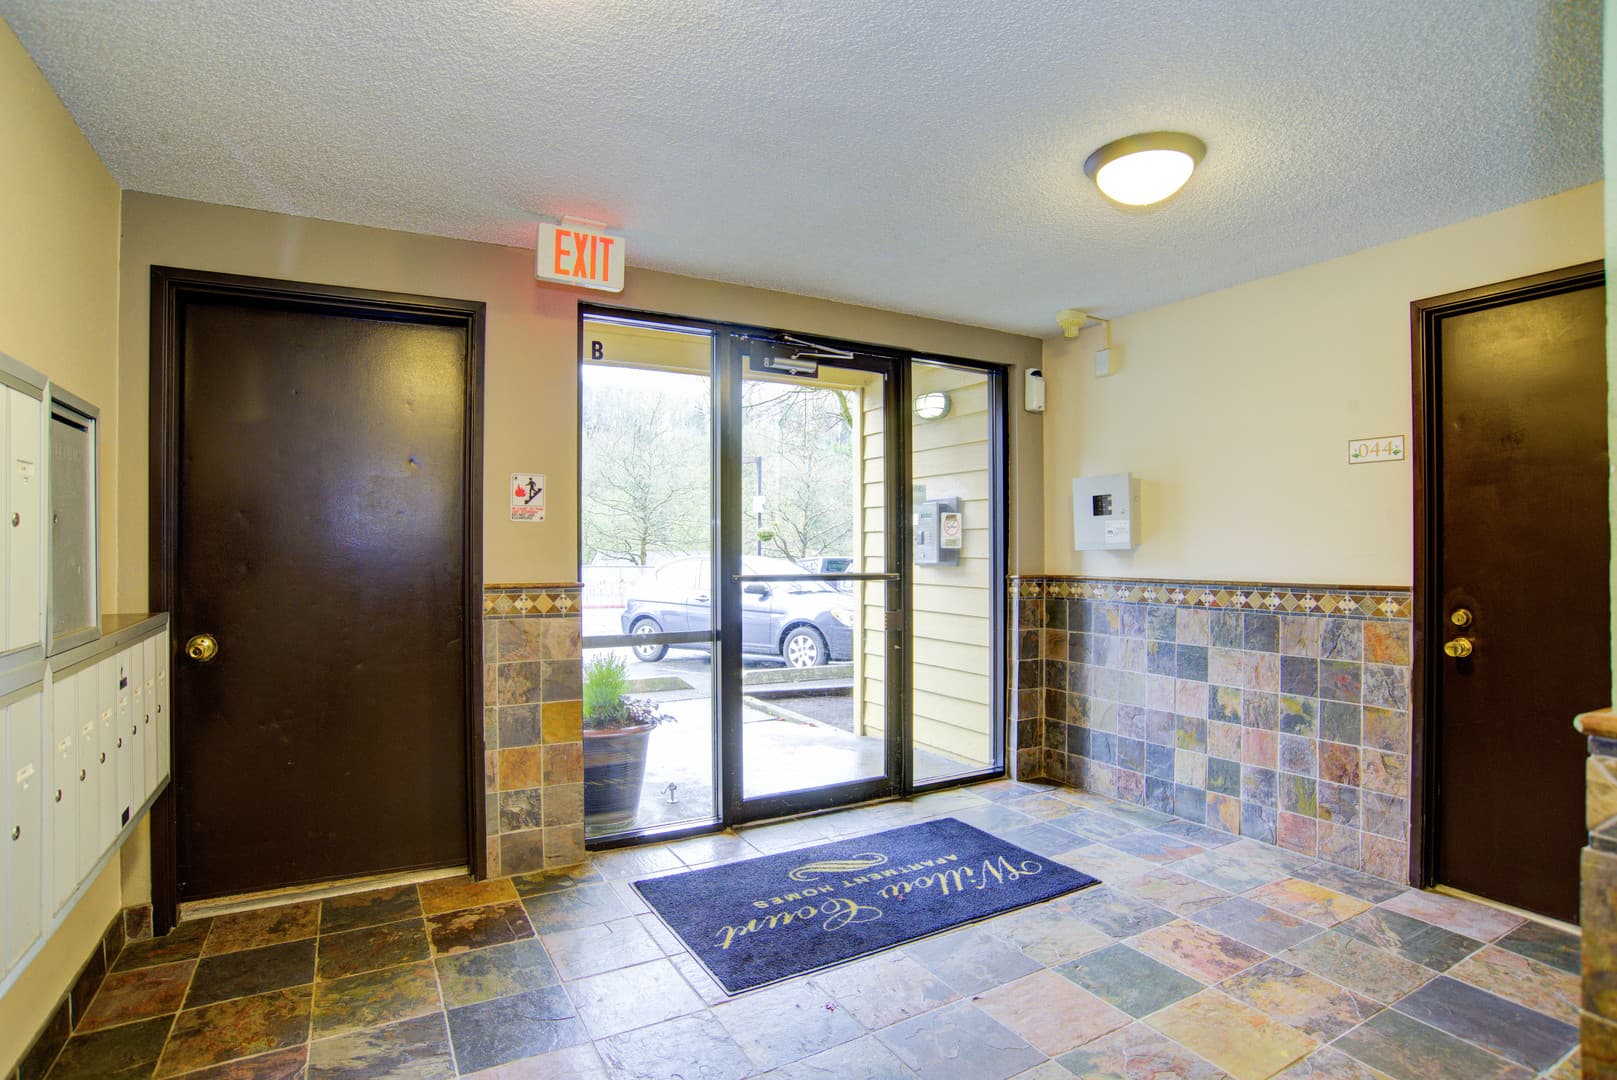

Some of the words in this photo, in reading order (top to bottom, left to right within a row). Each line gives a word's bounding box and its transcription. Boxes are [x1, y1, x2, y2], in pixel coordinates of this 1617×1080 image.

[553, 229, 615, 282] EXIT
[592, 341, 603, 361] B
[1359, 440, 1393, 458] 044
[842, 854, 958, 888] APARTMENT
[876, 855, 1042, 899] Willow
[752, 884, 834, 908] HOMES
[714, 896, 883, 949] Court
